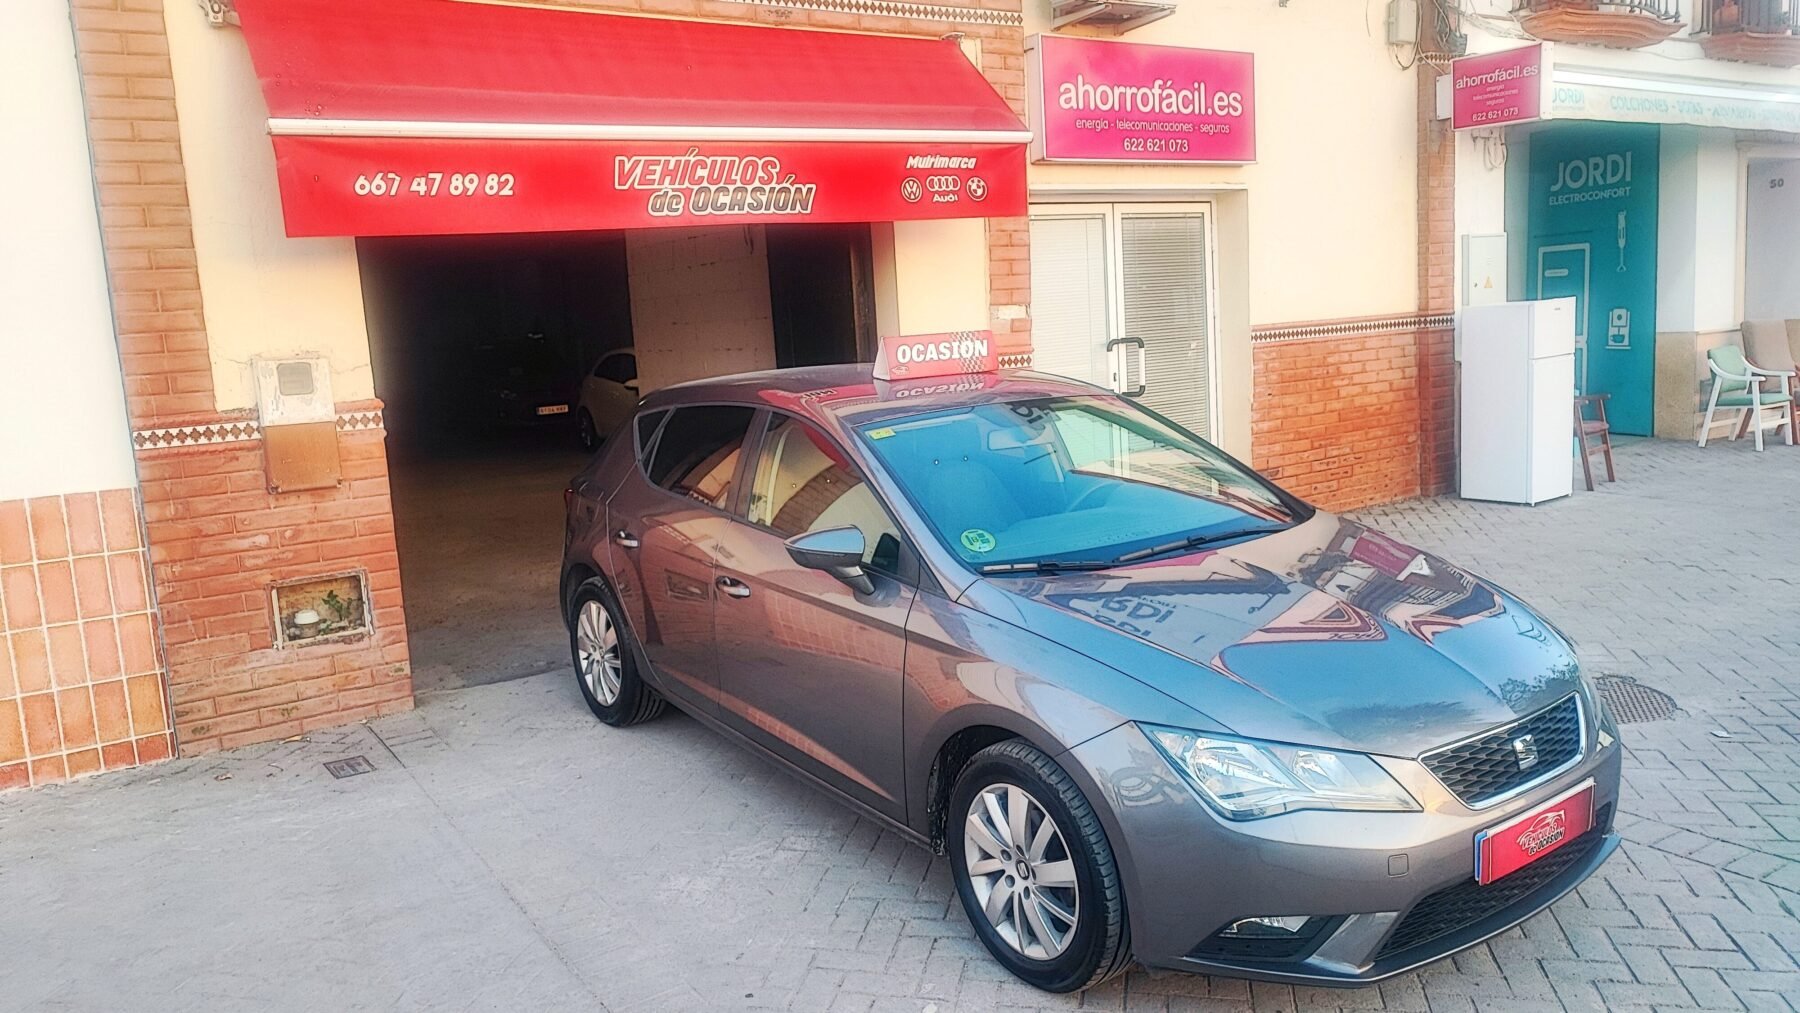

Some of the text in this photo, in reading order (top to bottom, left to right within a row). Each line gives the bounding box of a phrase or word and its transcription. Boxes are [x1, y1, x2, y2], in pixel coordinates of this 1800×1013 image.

[1456, 64, 1538, 89] ahorrofácil.es
[1058, 73, 1243, 117] ahorrofácil.es
[1488, 110, 1502, 119] 621
[1504, 107, 1519, 117] 073
[1075, 117, 1230, 136] energía telecomunicaciones seguros
[1123, 138, 1189, 152] 622 621 073
[614, 147, 779, 189] VEHÍCULOS
[906, 155, 977, 169] Multimarca
[1550, 151, 1632, 192] JORDI
[354, 172, 515, 196] 667 47 89 82
[1769, 178, 1784, 189] 50
[648, 175, 816, 216] de OCASIÓN
[932, 193, 959, 202] Audi
[1549, 186, 1632, 206] ELECTROCONFORT
